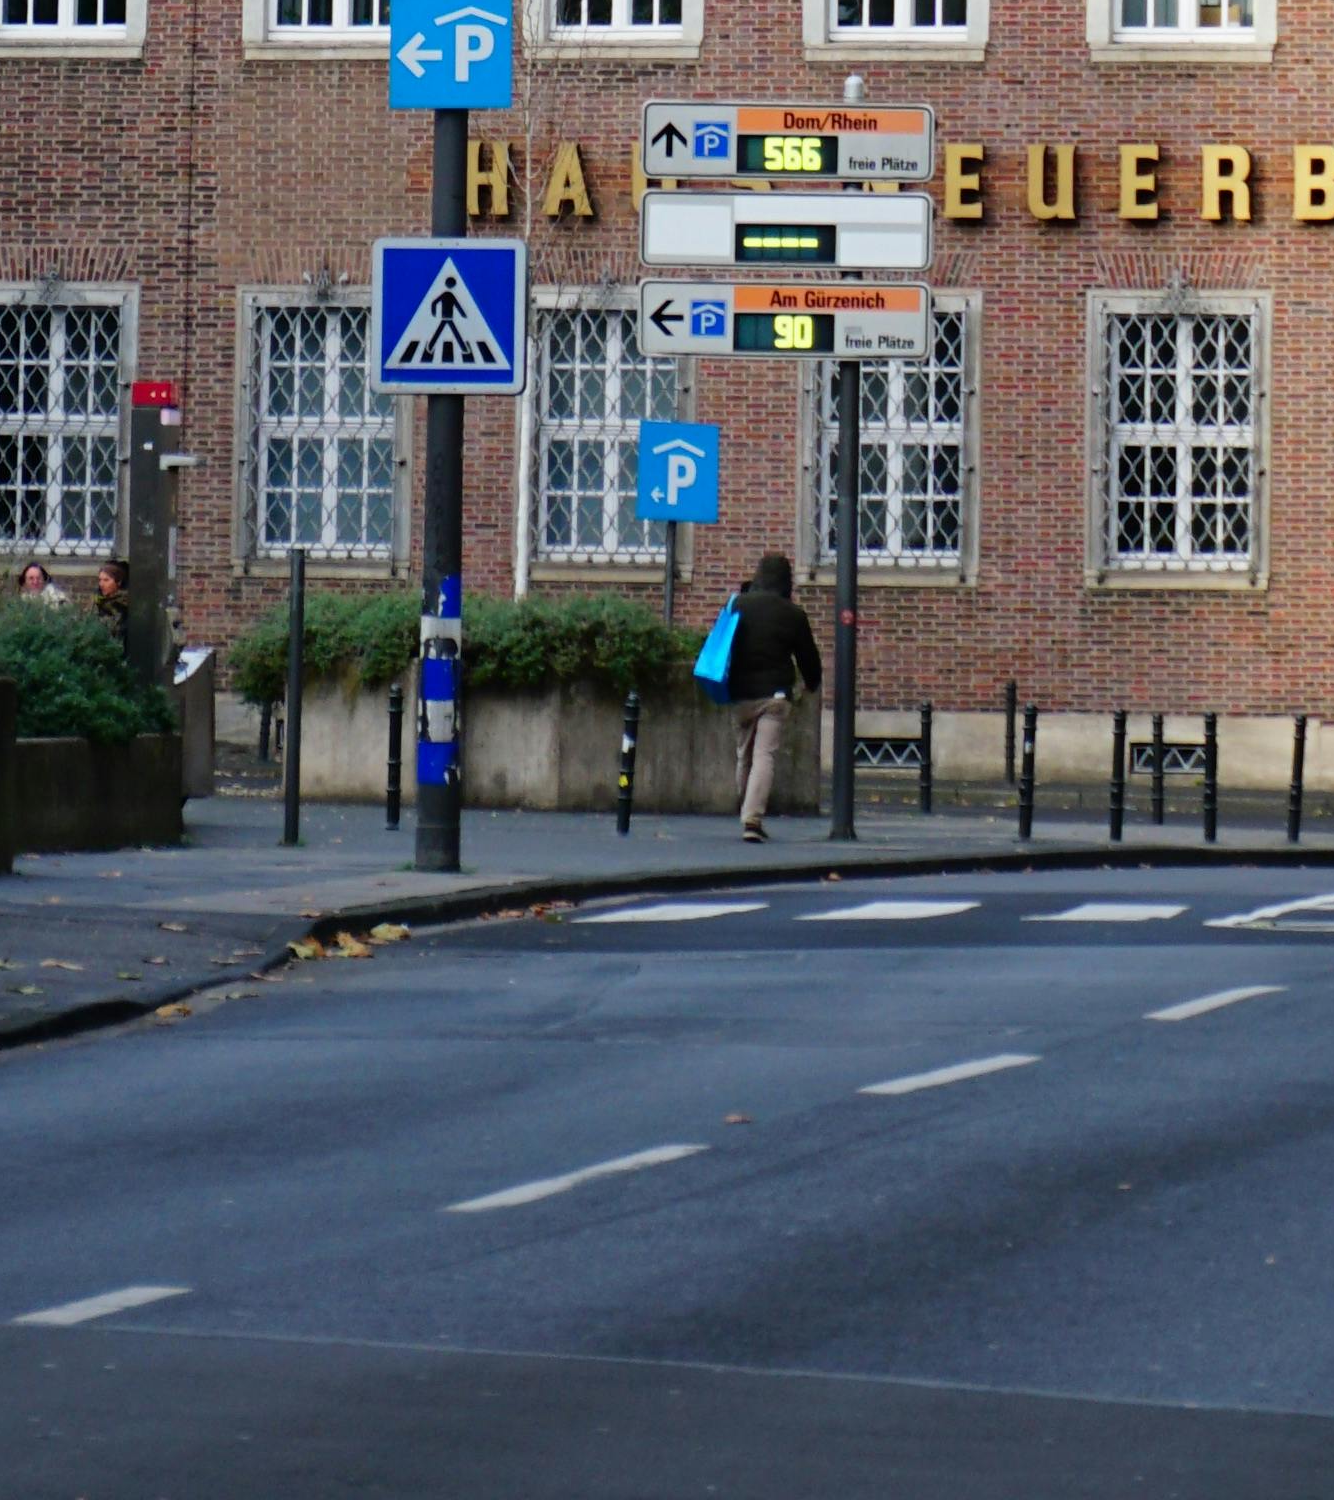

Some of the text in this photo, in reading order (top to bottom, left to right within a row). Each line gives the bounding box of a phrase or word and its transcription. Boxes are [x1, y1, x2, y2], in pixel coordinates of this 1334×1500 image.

[454, 24, 495, 82] P
[783, 111, 878, 132] Dom/Rhein
[703, 134, 720, 156] P
[764, 136, 822, 171] 566
[848, 156, 918, 172] freie Plätze
[769, 289, 885, 311] Am Gürzenich
[700, 312, 717, 335] P
[773, 314, 813, 349] 90
[845, 335, 915, 350] freie Plätze
[666, 454, 697, 506] P
